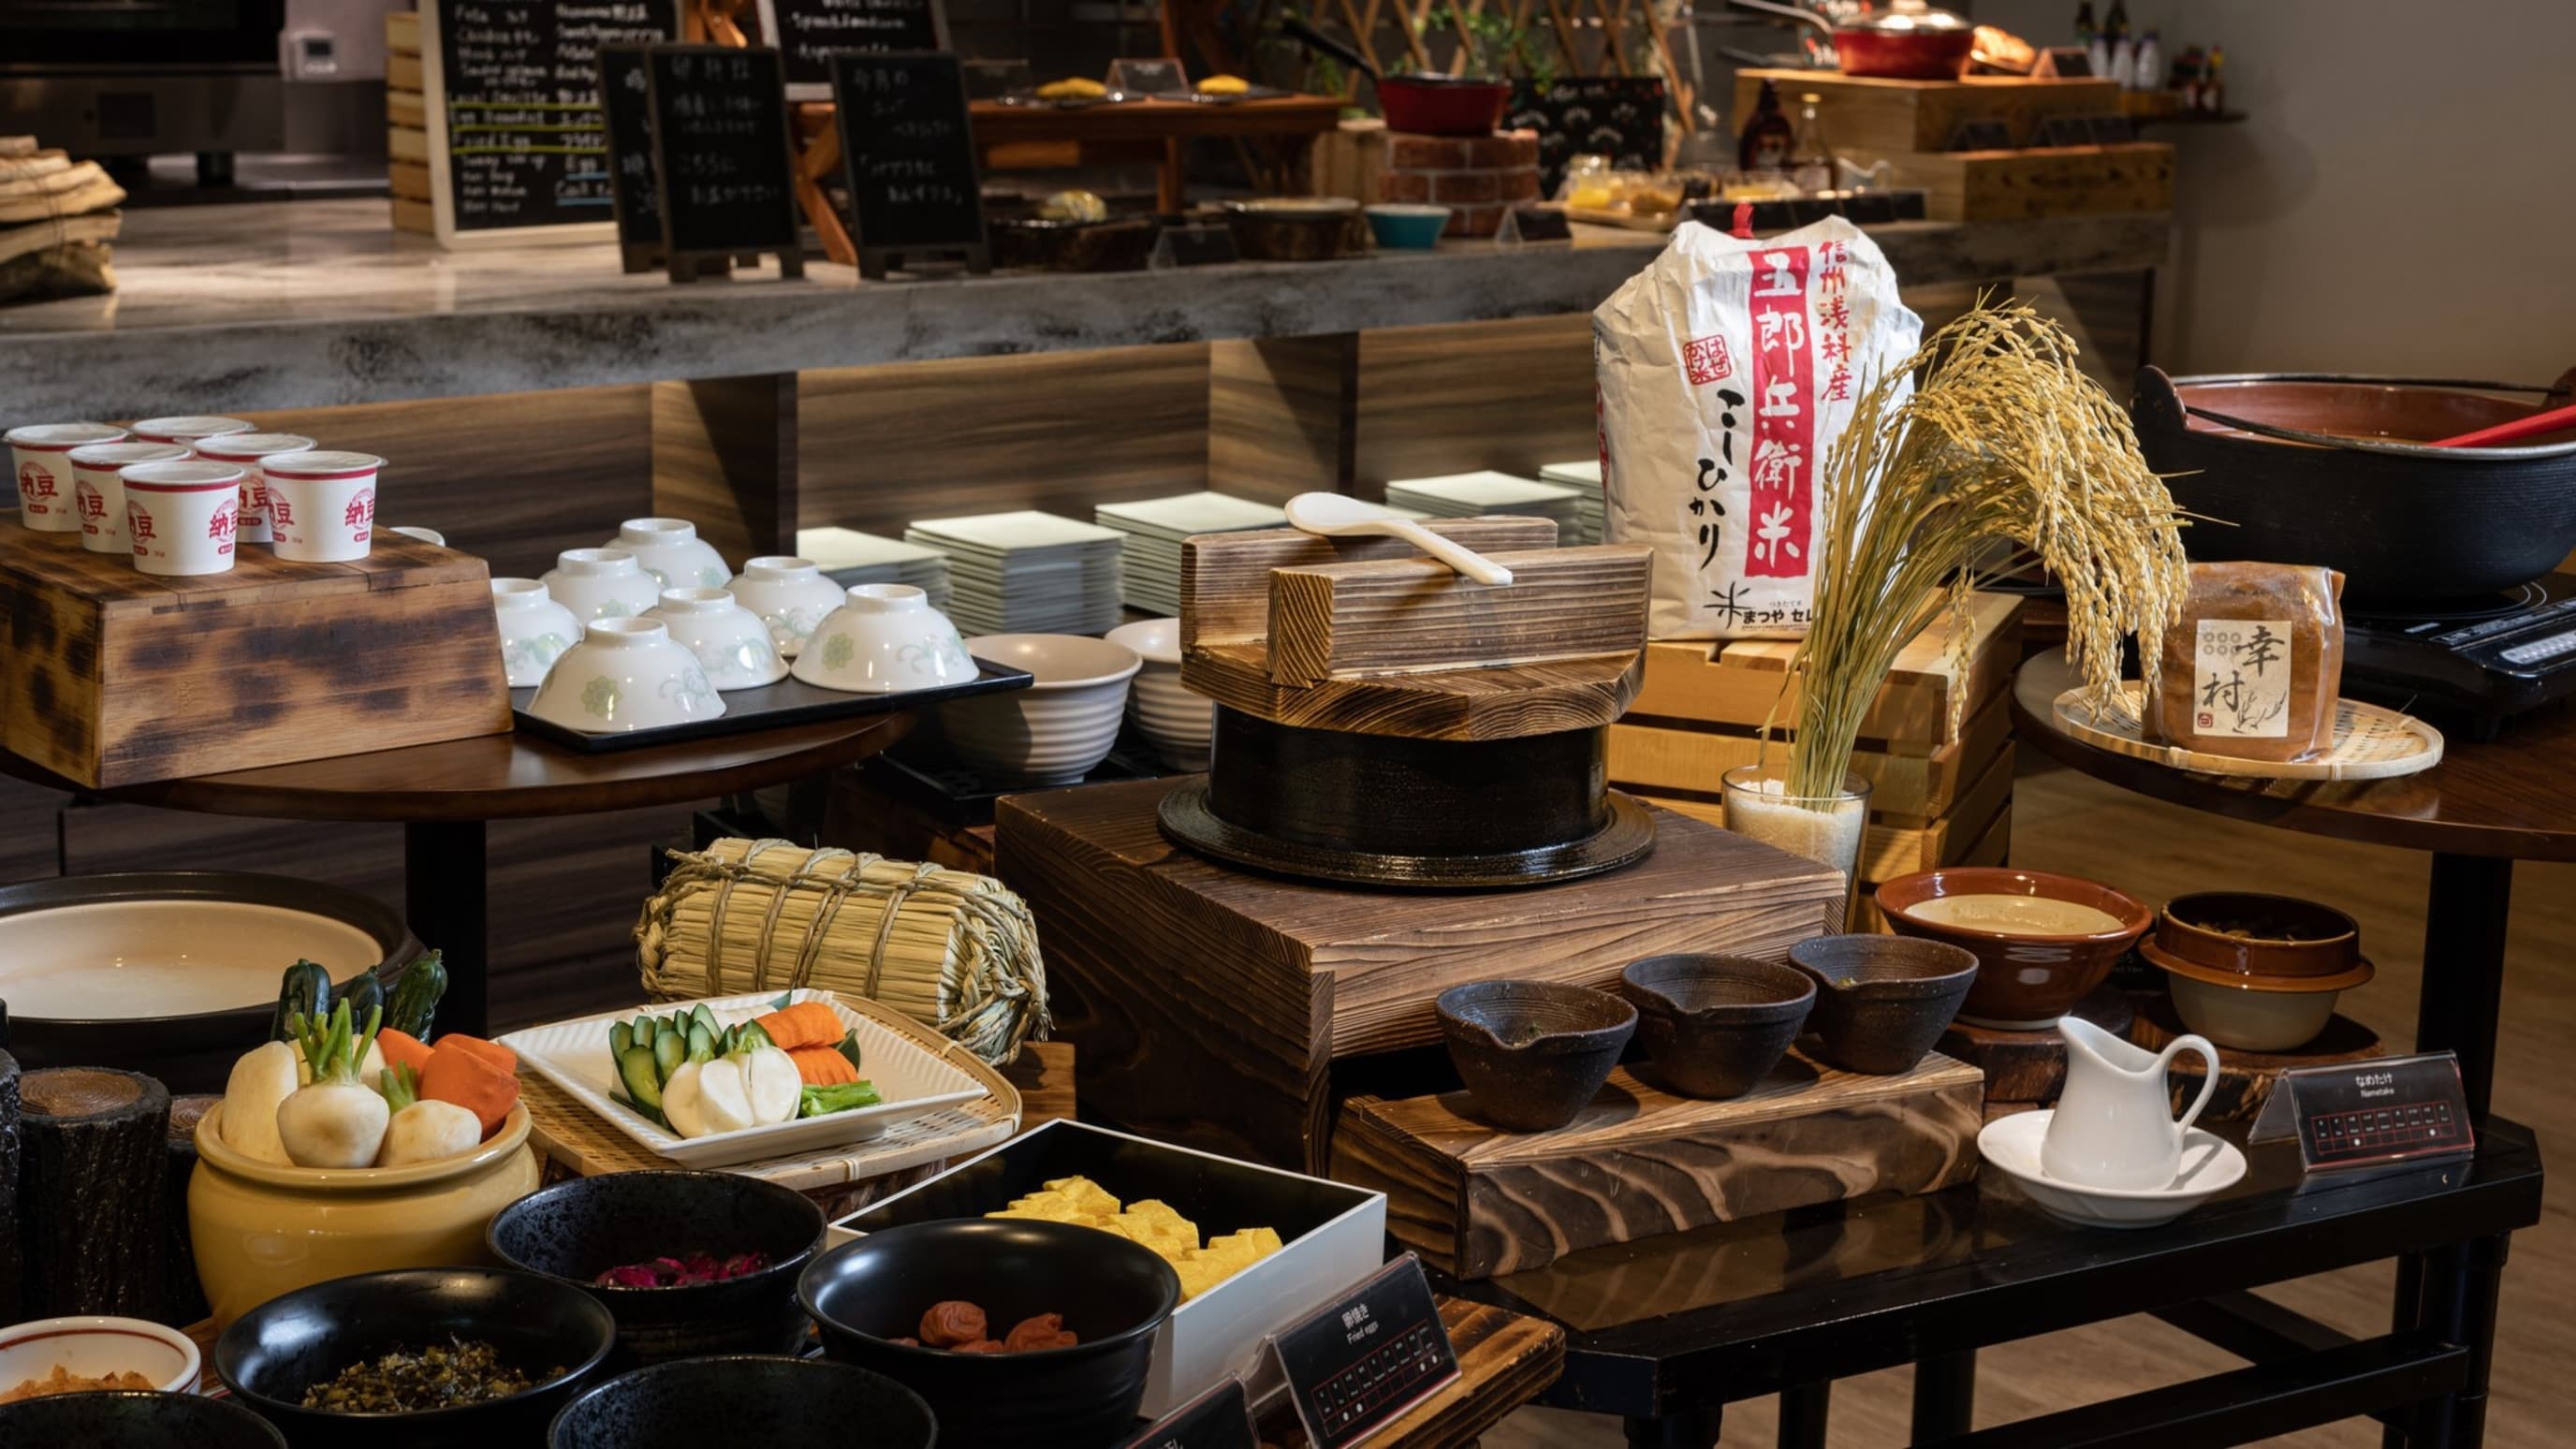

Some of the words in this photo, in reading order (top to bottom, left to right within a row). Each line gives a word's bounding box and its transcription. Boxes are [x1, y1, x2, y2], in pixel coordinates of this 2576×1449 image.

[1818, 241, 1852, 402] 信州浅科産
[1754, 253, 1805, 569] 五郎兵衛米
[1743, 609, 1785, 624] まつや
[2202, 624, 2285, 713] 幸村
